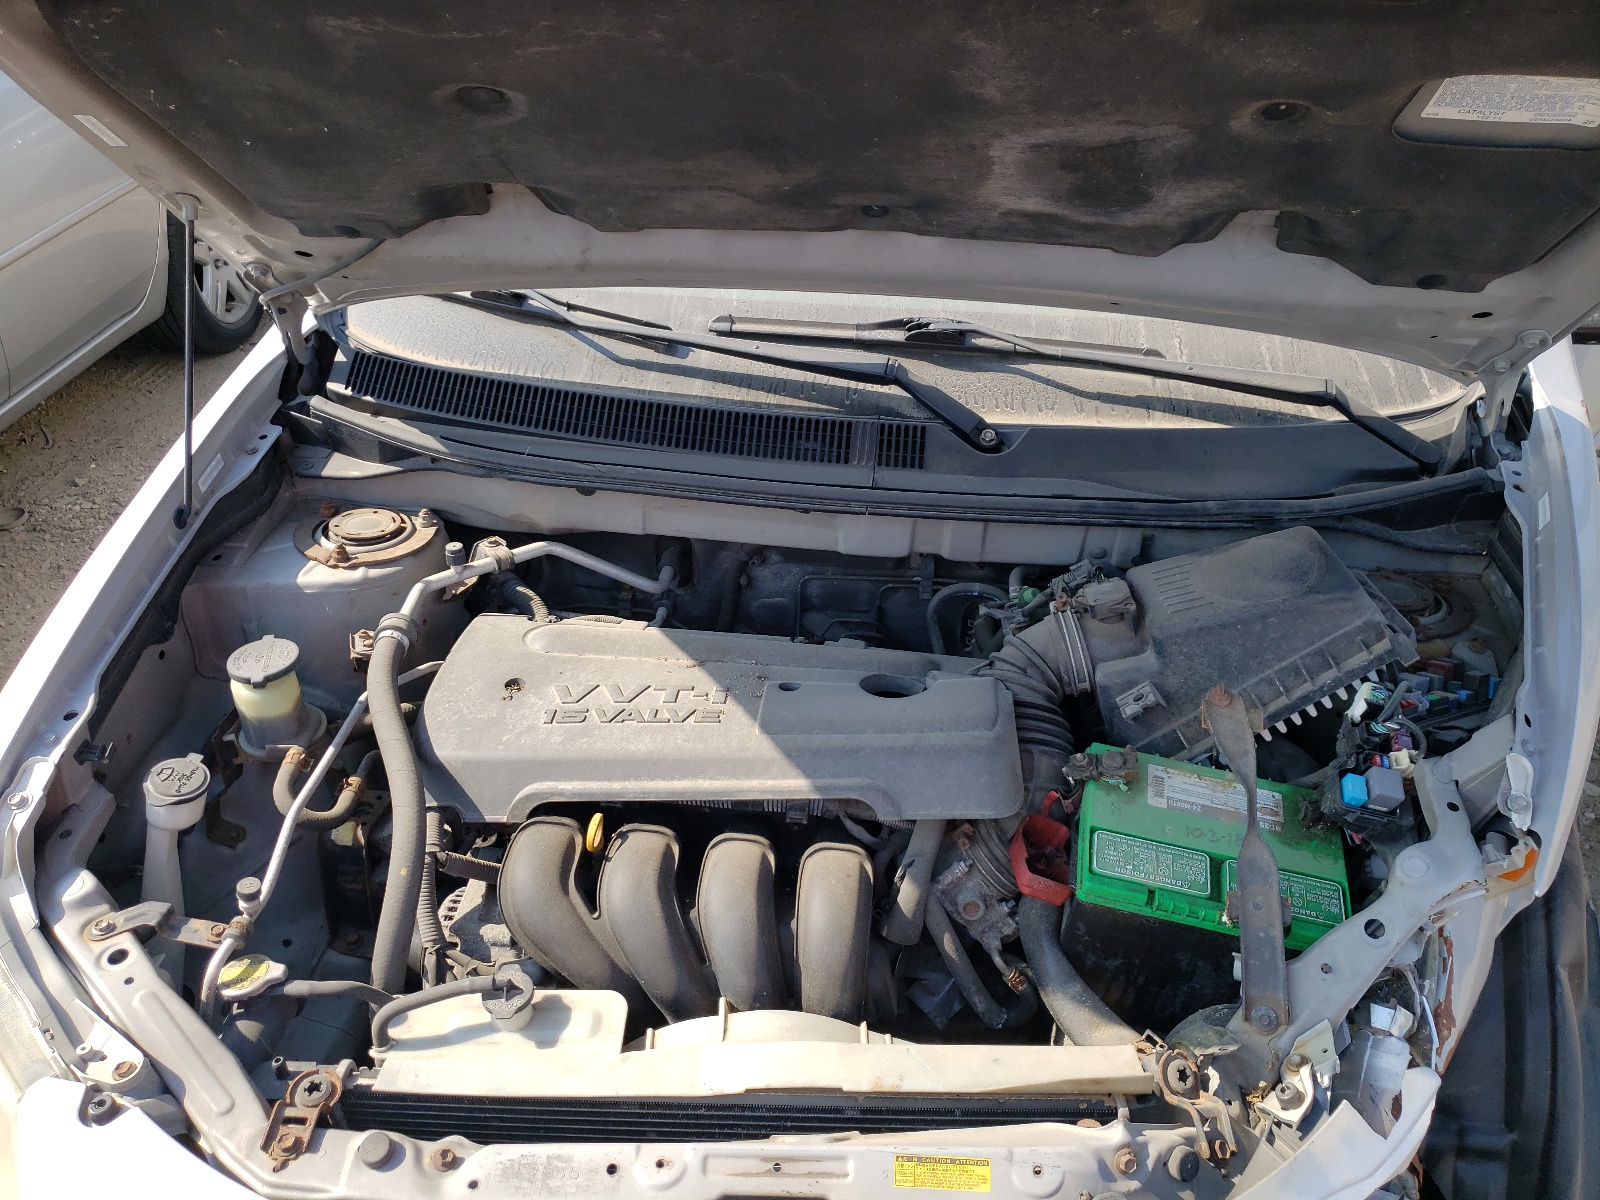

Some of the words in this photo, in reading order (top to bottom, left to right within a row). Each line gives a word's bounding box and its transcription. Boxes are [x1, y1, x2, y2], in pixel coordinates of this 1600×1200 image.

[543, 707, 590, 725] 16
[593, 707, 724, 725] VALVE
[921, 1156, 951, 1164] CAUTION
[955, 1158, 988, 1166] ATTENTION
